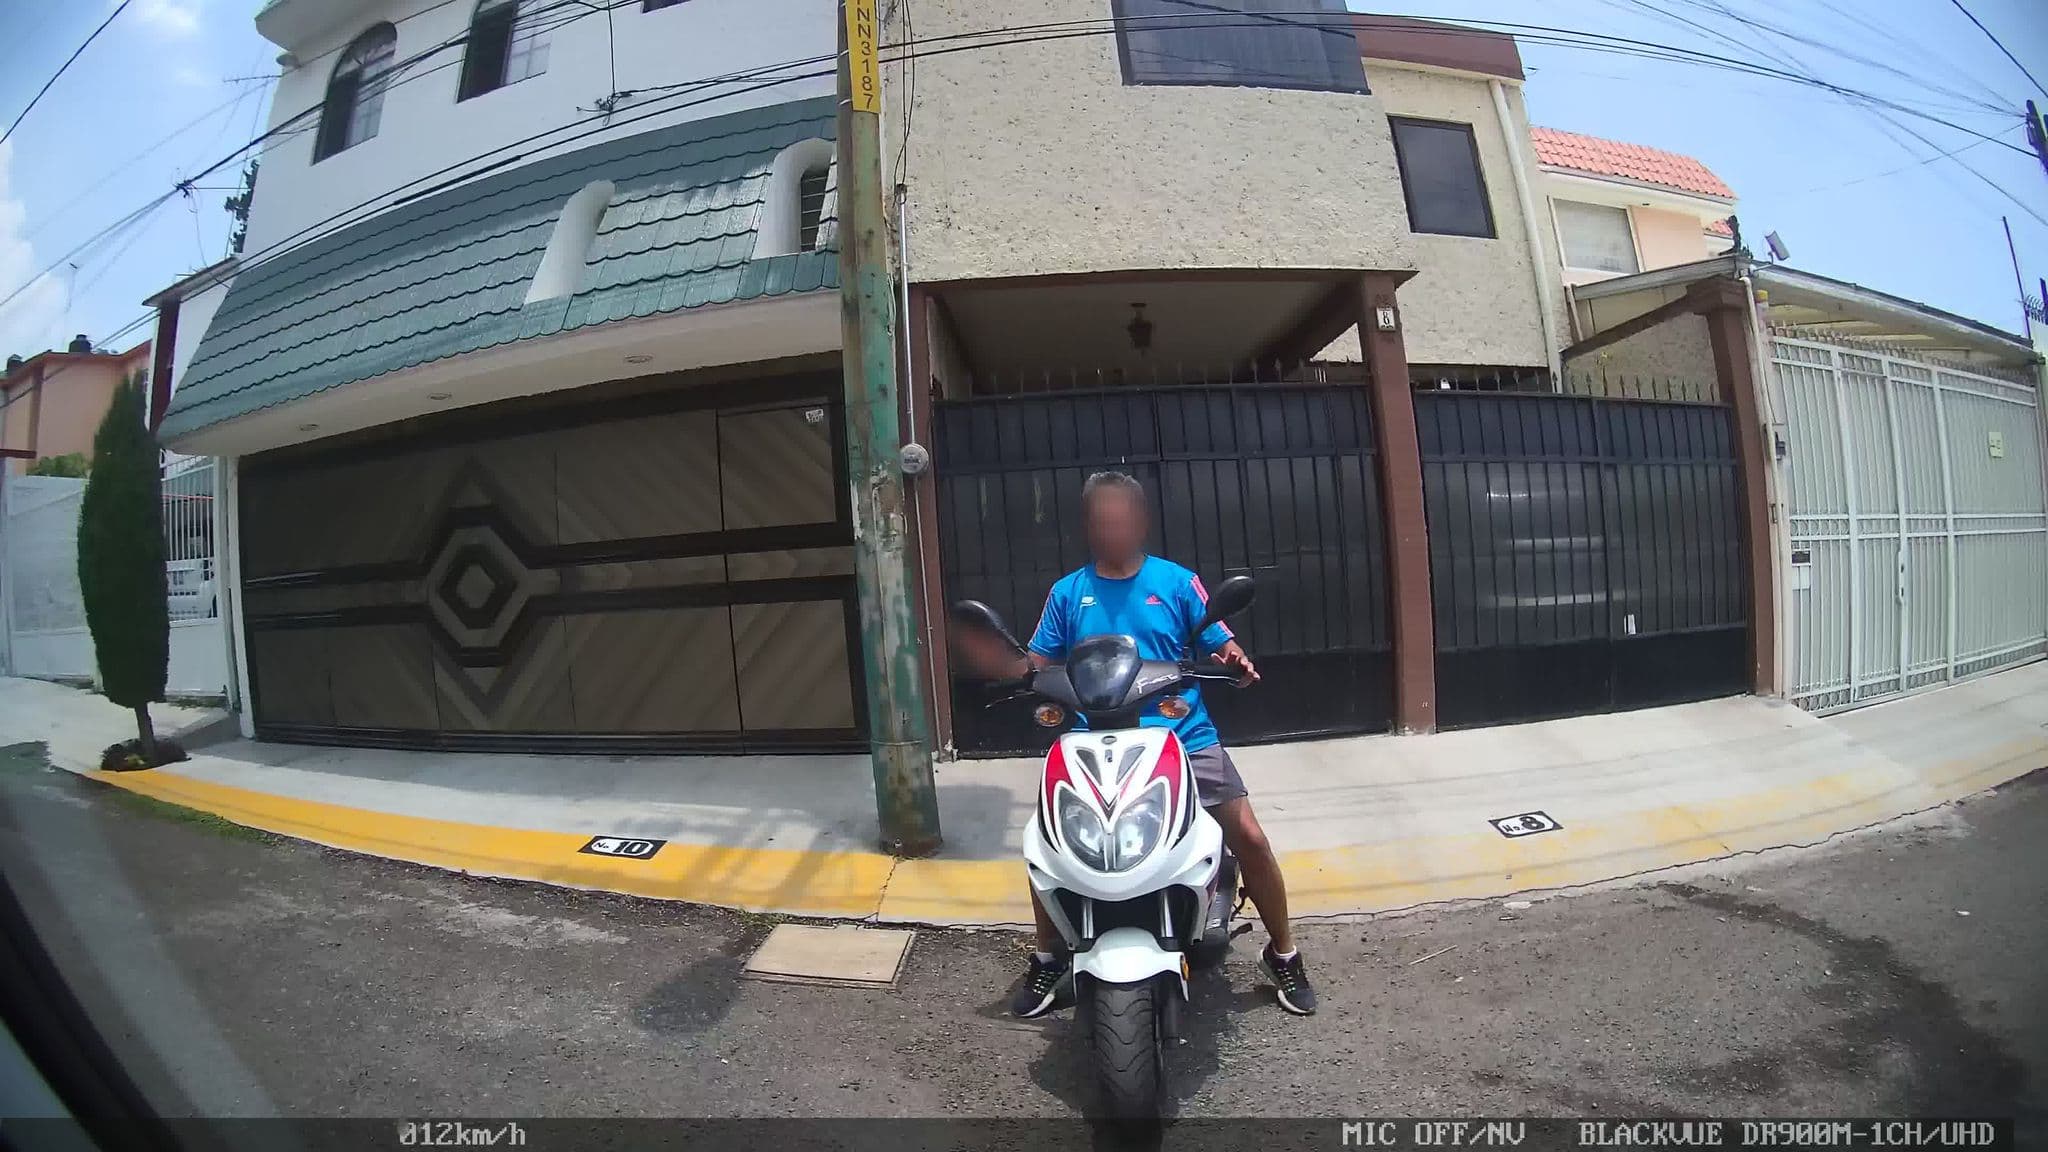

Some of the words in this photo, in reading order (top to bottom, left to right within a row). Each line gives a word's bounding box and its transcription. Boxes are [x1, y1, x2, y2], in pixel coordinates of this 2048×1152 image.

[857, 0, 873, 109] NN3187
[1519, 816, 1545, 830] 8
[612, 841, 650, 854] 10
